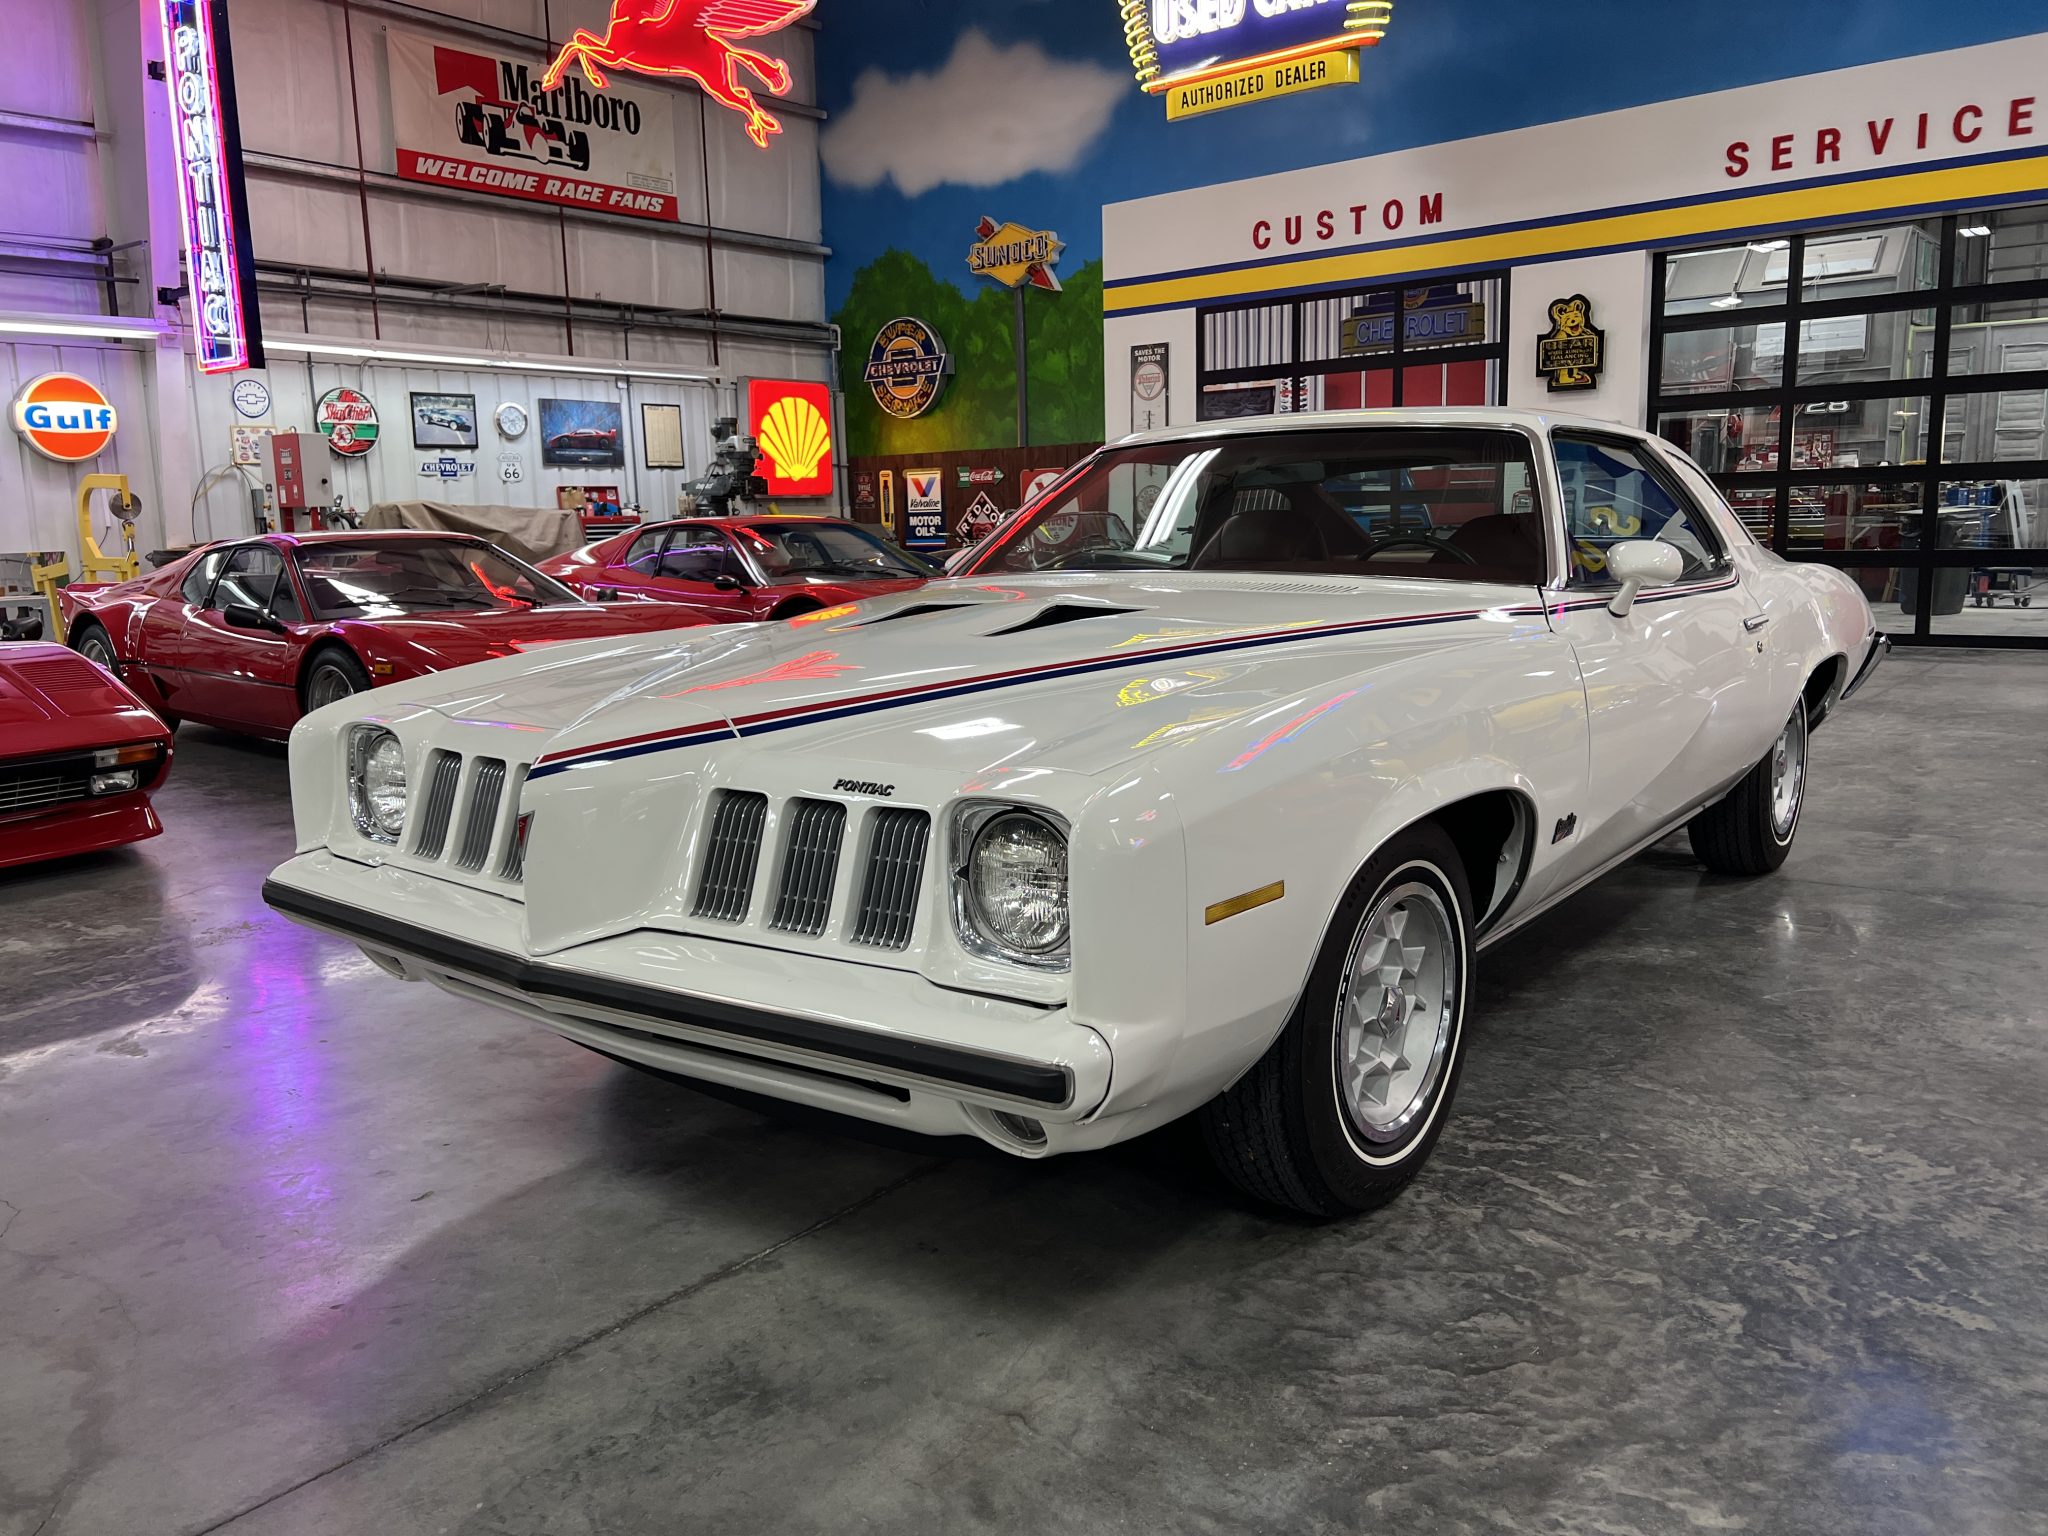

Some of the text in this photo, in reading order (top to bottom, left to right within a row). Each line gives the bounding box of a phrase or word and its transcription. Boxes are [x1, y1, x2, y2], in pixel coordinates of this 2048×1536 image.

[1181, 60, 1326, 109] AUTHORIZED DEALER
[500, 60, 641, 136] Marlboro
[1724, 96, 2036, 178] SERVICE
[174, 26, 230, 335] PONTIAC
[415, 156, 538, 193] WELCOME
[545, 178, 603, 203] RACE
[609, 190, 664, 213] FANS
[1252, 192, 1443, 250] CUSTOM
[973, 235, 1048, 270] SUNOCO
[878, 322, 926, 348] SUPER
[1356, 310, 1468, 344] CHEROLET
[1134, 349, 1153, 357] SAVES
[1137, 354, 1161, 363] MOTOR
[869, 360, 939, 377] CHEVROLET
[877, 380, 933, 413] SERVICE
[24, 404, 112, 430] Gulf
[424, 463, 473, 472] CHEVROLET
[504, 468, 520, 479] 66
[969, 470, 994, 482] Coca-Cola
[909, 499, 940, 509] Valvoline
[909, 515, 942, 527] MOTOR
[915, 527, 936, 537] OILS
[960, 504, 1000, 534] RED DO
[832, 778, 896, 797] PONTIAC
